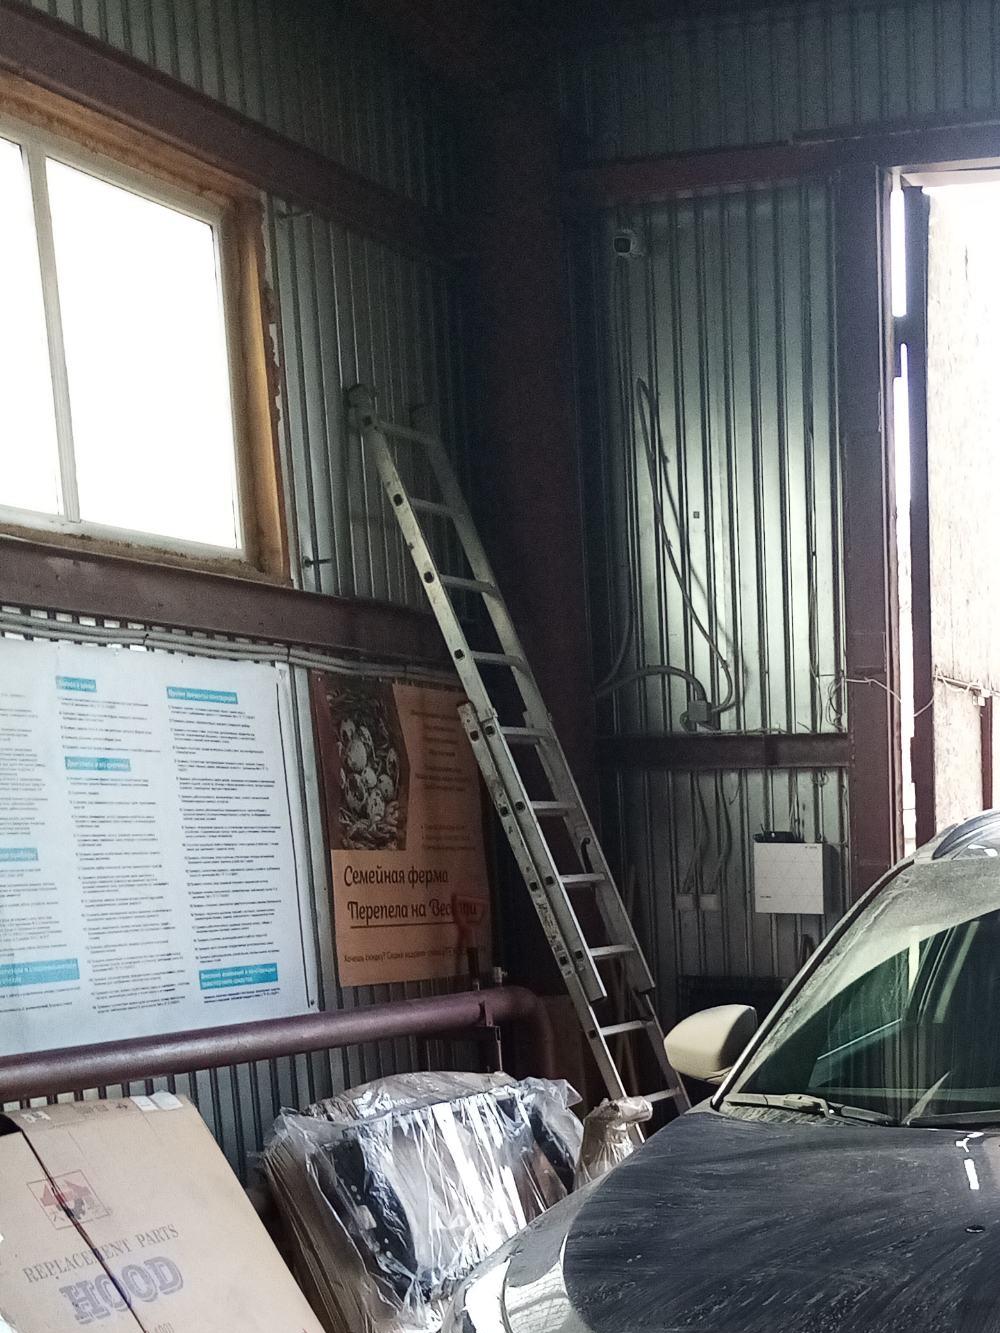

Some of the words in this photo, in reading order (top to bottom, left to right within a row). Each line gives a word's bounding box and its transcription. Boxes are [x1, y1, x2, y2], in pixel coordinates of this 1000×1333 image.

[344, 865, 406, 888] Семейная
[408, 866, 449, 889] ферма
[347, 900, 409, 926] Перепела
[411, 903, 427, 918] на
[22, 1237, 134, 1284] REPLACEMENT
[134, 1223, 180, 1248] PARTS
[59, 1256, 184, 1325] HOOD
